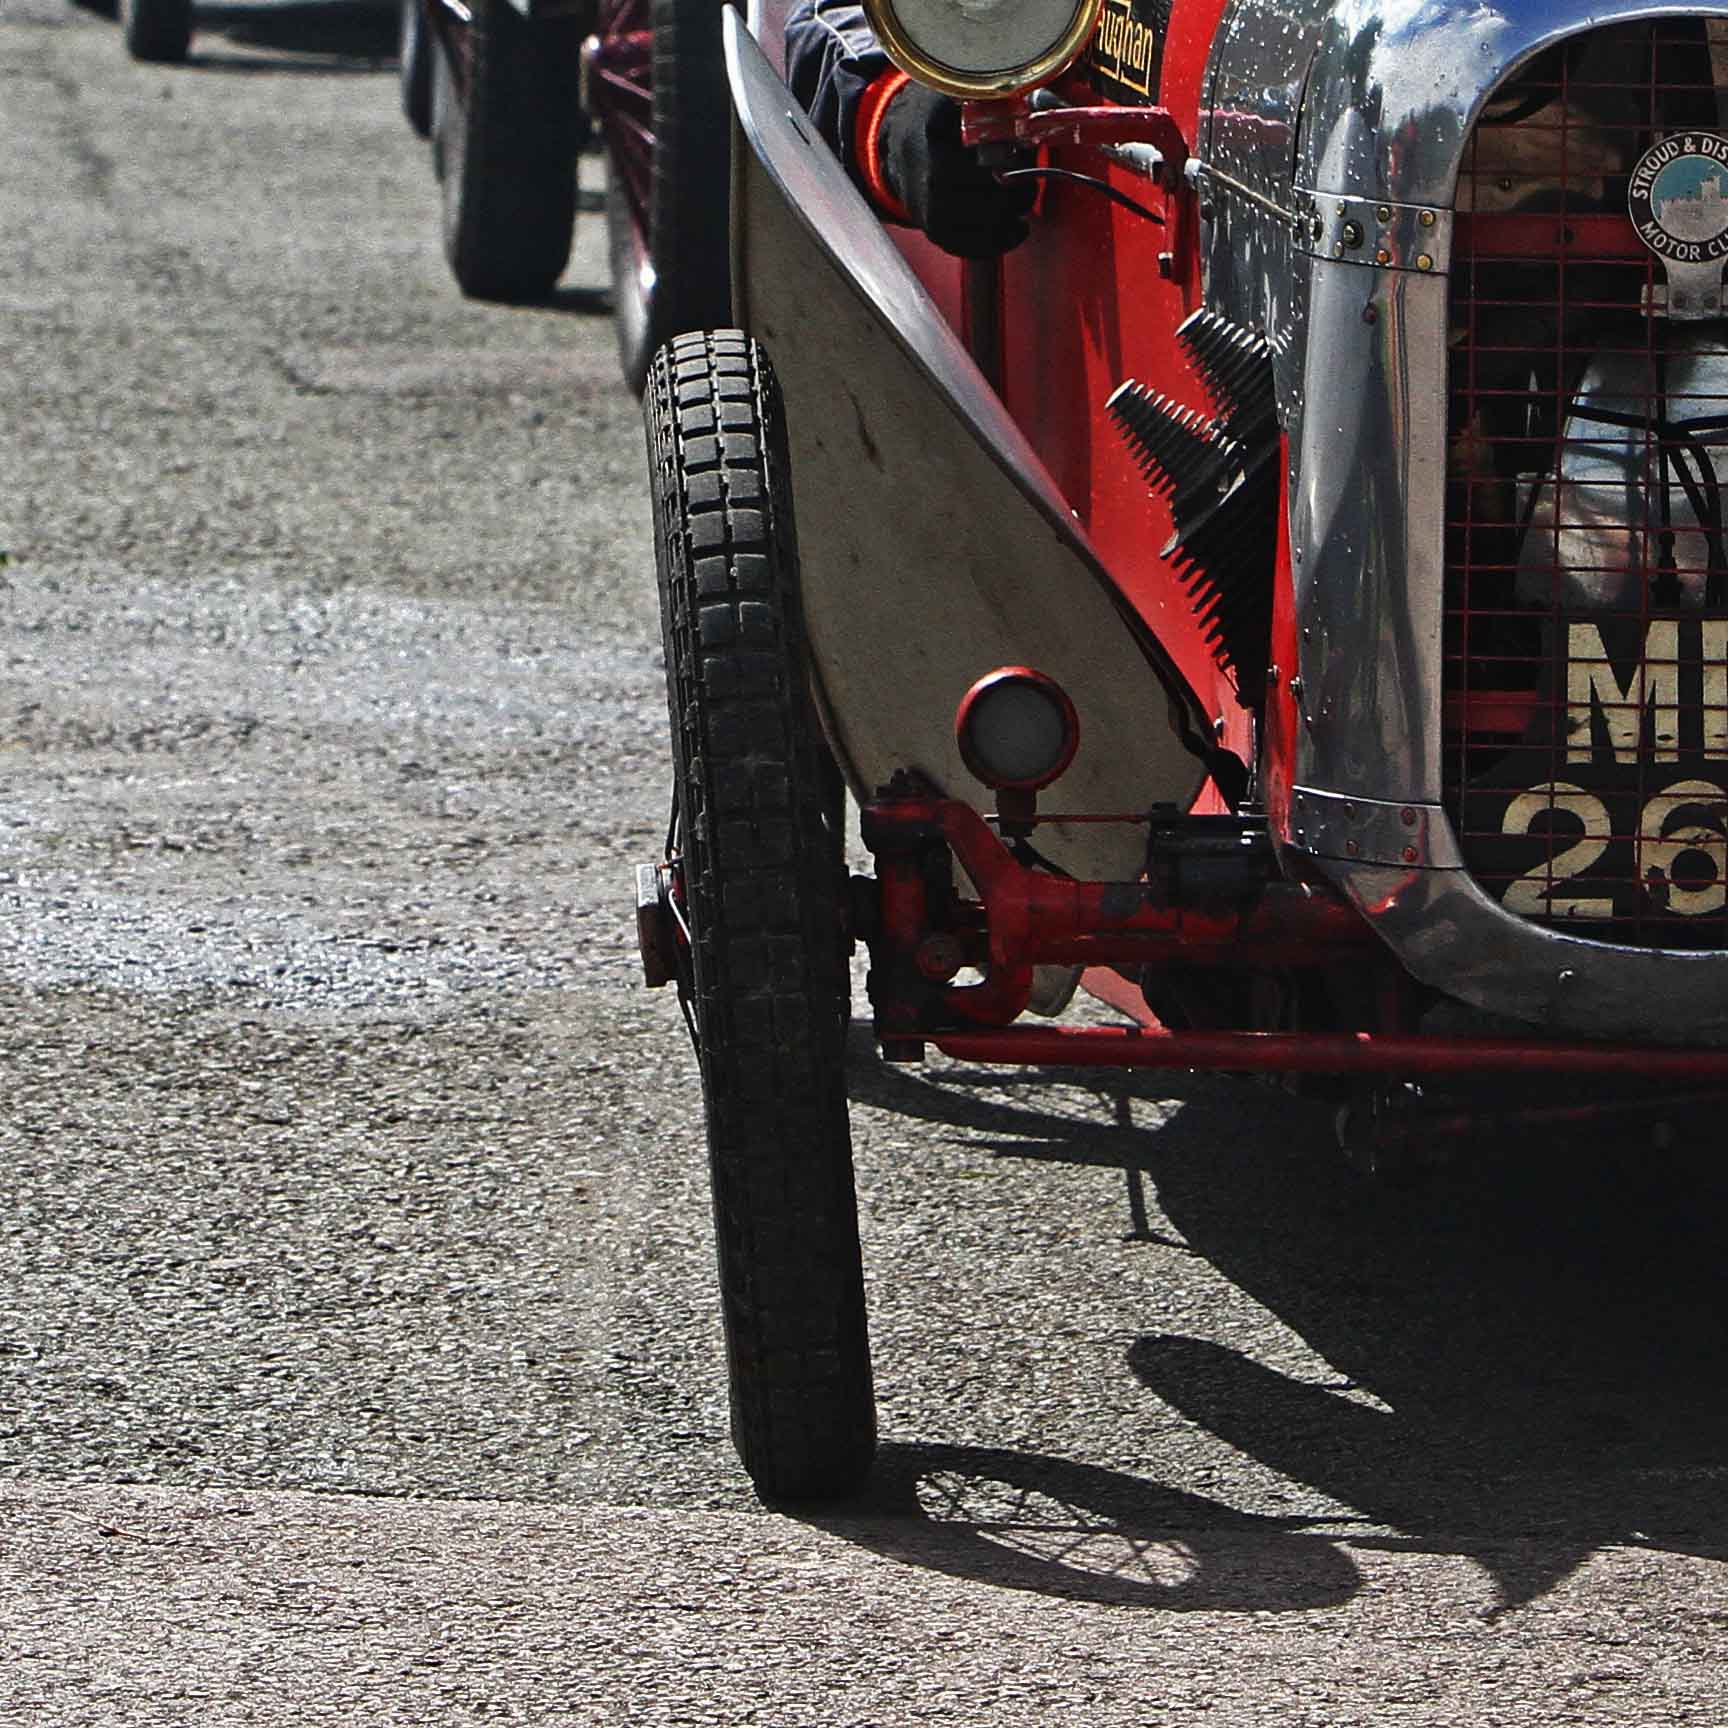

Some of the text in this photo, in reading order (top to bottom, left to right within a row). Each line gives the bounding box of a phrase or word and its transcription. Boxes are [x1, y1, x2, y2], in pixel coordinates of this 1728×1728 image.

[1632, 140, 1680, 200] STROUD
[1683, 136, 1697, 152] &
[1639, 221, 1702, 260] MOTOR
